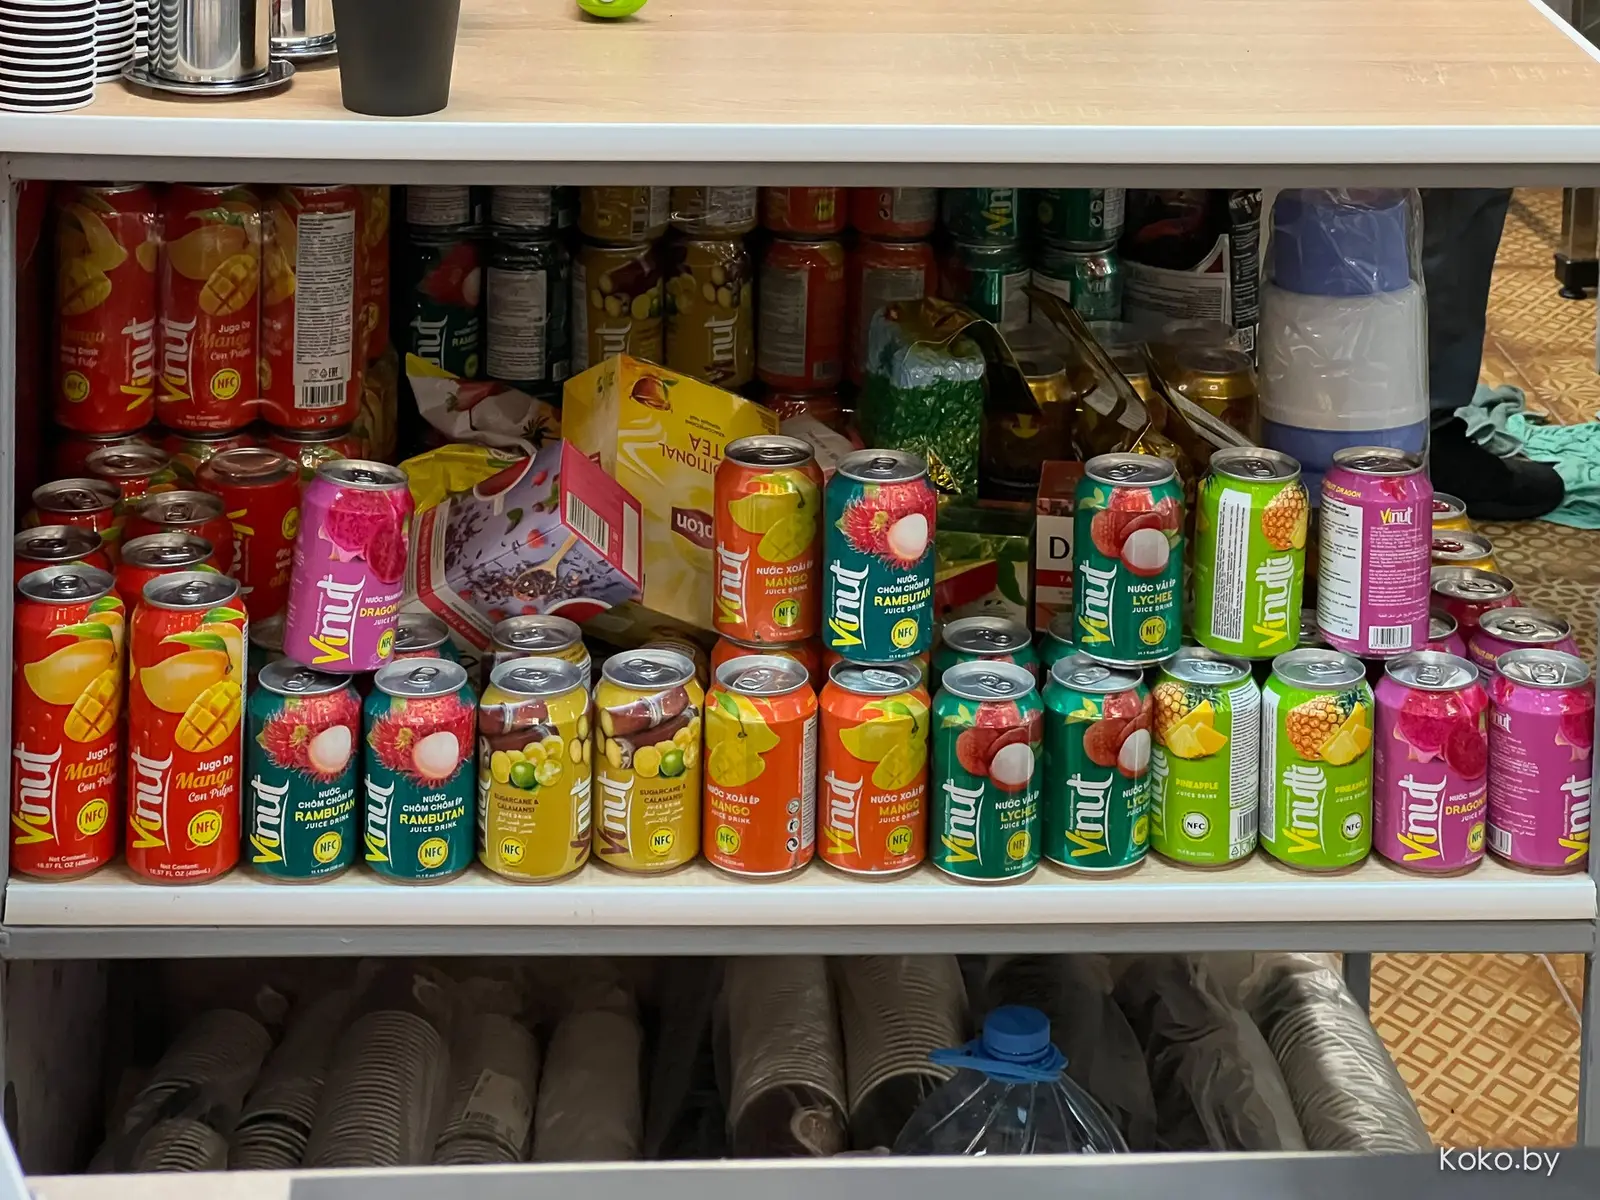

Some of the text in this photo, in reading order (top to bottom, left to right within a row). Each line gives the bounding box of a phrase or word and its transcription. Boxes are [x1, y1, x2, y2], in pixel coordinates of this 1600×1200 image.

[218, 322, 240, 334] Jugo
[210, 350, 228, 362] Con
[216, 377, 236, 390] NFC
[689, 433, 721, 460] TEA
[658, 442, 714, 474] ITIONAL
[1335, 485, 1362, 499] DRAGON
[1380, 506, 1413, 525] Vinut
[677, 513, 714, 540] pton
[716, 541, 750, 624] Vinut
[765, 573, 808, 588] MANGO
[764, 584, 808, 596] JUICE DRINK
[874, 587, 931, 607] RAMBUTAN
[1132, 590, 1173, 606] LYCHEE
[828, 559, 869, 647] Vinut
[884, 602, 925, 615] JUICE DRINK
[1078, 559, 1117, 644] Vinut
[1132, 602, 1173, 614] JUICE DRINK
[309, 574, 366, 664] Vinut
[778, 605, 797, 617] NFC
[897, 626, 914, 638] NFC
[1145, 622, 1162, 635] NFC
[381, 635, 393, 649] NFC
[86, 748, 109, 761] Jugo
[196, 755, 234, 773] Jugo De
[175, 766, 234, 790] Mango
[1175, 778, 1219, 790] PINEAPPLE
[11, 741, 62, 845] Vinut
[77, 781, 96, 793] Con
[187, 784, 234, 803] Con Pulpa
[129, 746, 174, 849] Vinut
[85, 807, 104, 823] NFC
[295, 798, 355, 822] RAMBUTAN
[399, 805, 465, 825] RAMBUTAN
[597, 771, 635, 855] Vinut
[711, 798, 750, 816] MANGO
[824, 770, 863, 854] Vinut
[879, 799, 920, 816] MANGO
[1000, 802, 1037, 822] LYCHEE
[1065, 773, 1113, 857] Vinut
[250, 774, 289, 863] Vinut
[305, 814, 349, 830] JUICE DRINK
[364, 774, 395, 863] Vinut
[728, 815, 751, 824] DRINK
[878, 810, 920, 824] JUICE DRINK
[941, 778, 984, 863] Vinut
[1397, 773, 1447, 861] Vinut
[195, 820, 215, 834] NFC
[409, 822, 457, 833] JUICE DRINK
[1000, 822, 1020, 830] JUICE
[1186, 821, 1205, 830] NFC
[1345, 821, 1360, 832] NFC
[320, 839, 337, 853] NFC
[654, 834, 671, 846] NFC
[719, 832, 735, 845] NFC
[892, 834, 909, 845] NFC
[424, 846, 442, 858] NFC
[504, 843, 520, 856] NFC
